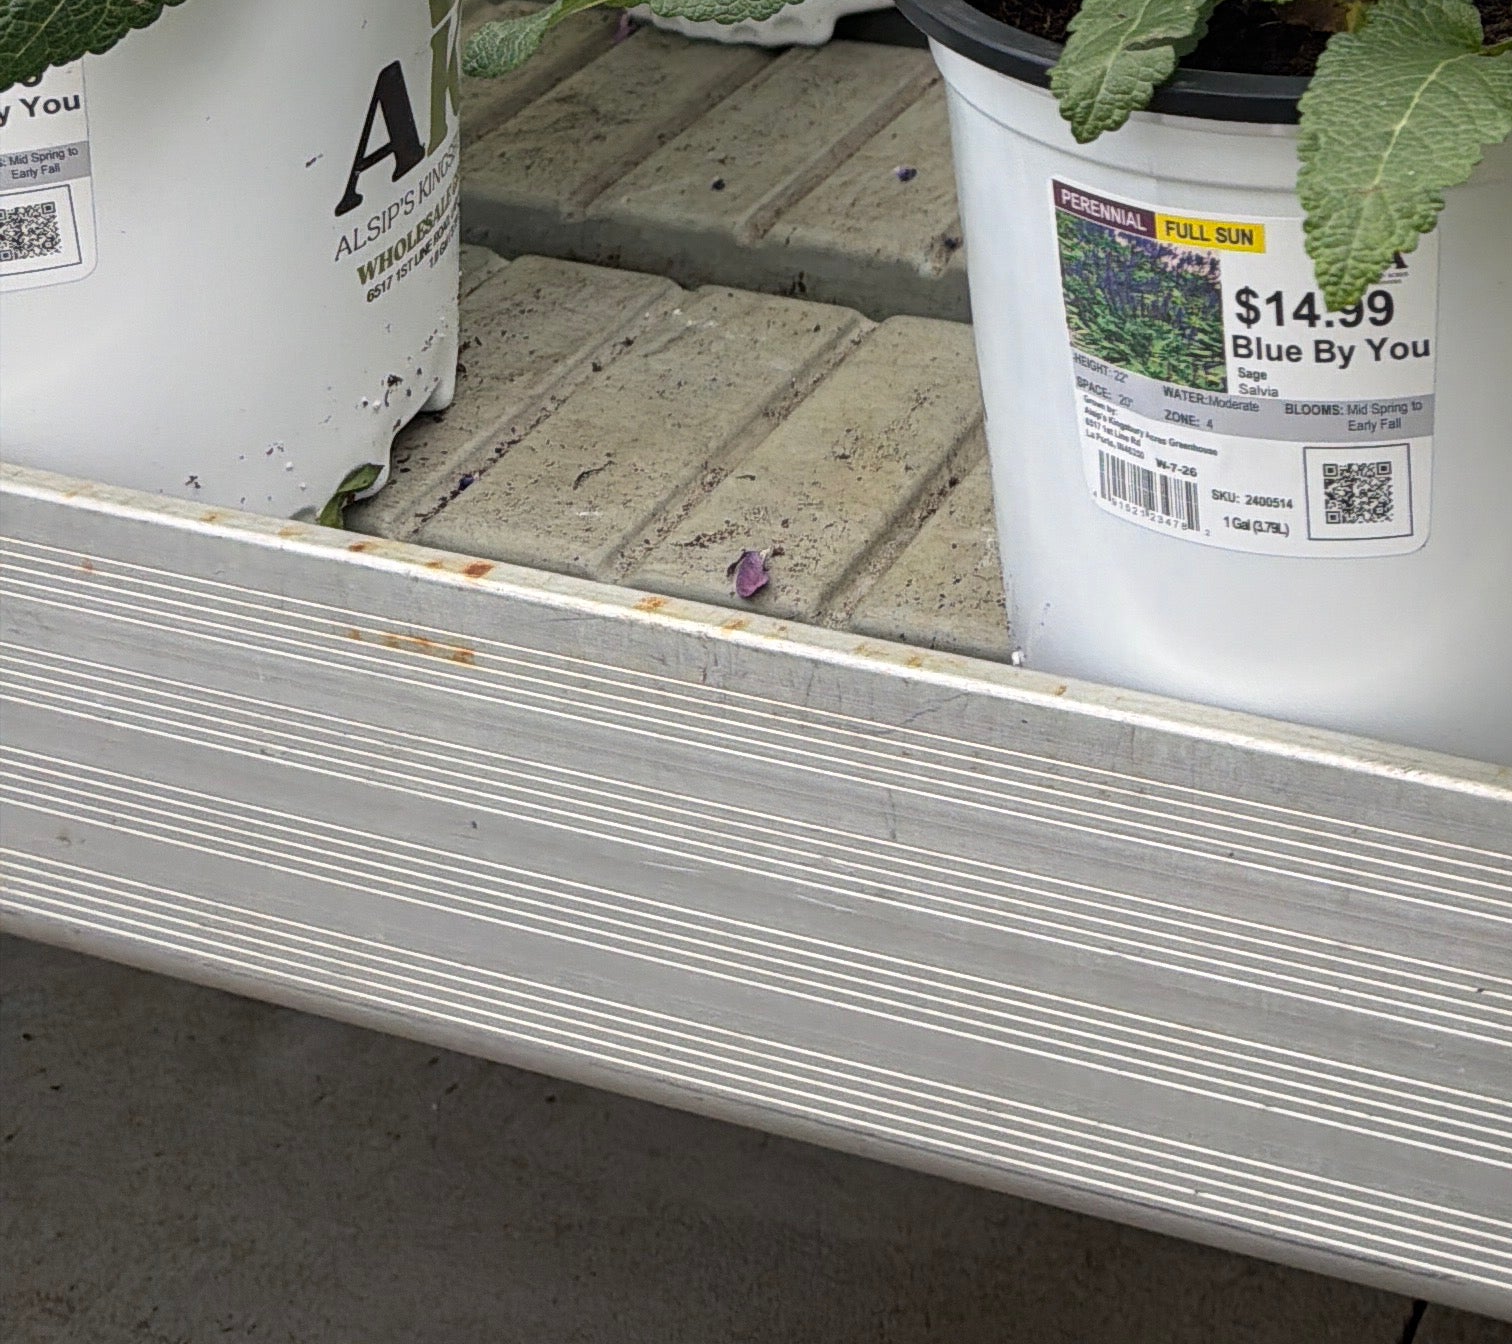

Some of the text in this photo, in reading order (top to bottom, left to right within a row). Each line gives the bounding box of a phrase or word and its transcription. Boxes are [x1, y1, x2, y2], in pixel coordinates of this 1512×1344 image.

[19, 95, 80, 118] You
[9, 155, 29, 166] Mid
[31, 149, 66, 164] Spring
[68, 147, 79, 157] to
[10, 163, 61, 180] Early Fall
[1061, 188, 1148, 232] PERENNIAL
[334, 190, 415, 262] ALSIP'S
[1165, 220, 1254, 247] FULL SUN
[366, 274, 393, 303] 6517
[396, 253, 413, 283] 1ST
[1231, 334, 1432, 370] Blue By You
[1073, 352, 1113, 377] HEIGHT:
[1237, 366, 1268, 382] Sage
[1238, 382, 1279, 398] Salvia
[1284, 399, 1423, 417] BLOOMS: Mid Spring to
[1164, 409, 1214, 430] ZONE: 4
[1347, 417, 1402, 433] Early Fall
[1168, 437, 1218, 456] Greenhouse
[1211, 488, 1294, 510] SKU: 2400514
[1223, 516, 1230, 529] 1
[1231, 517, 1251, 531] Gal
